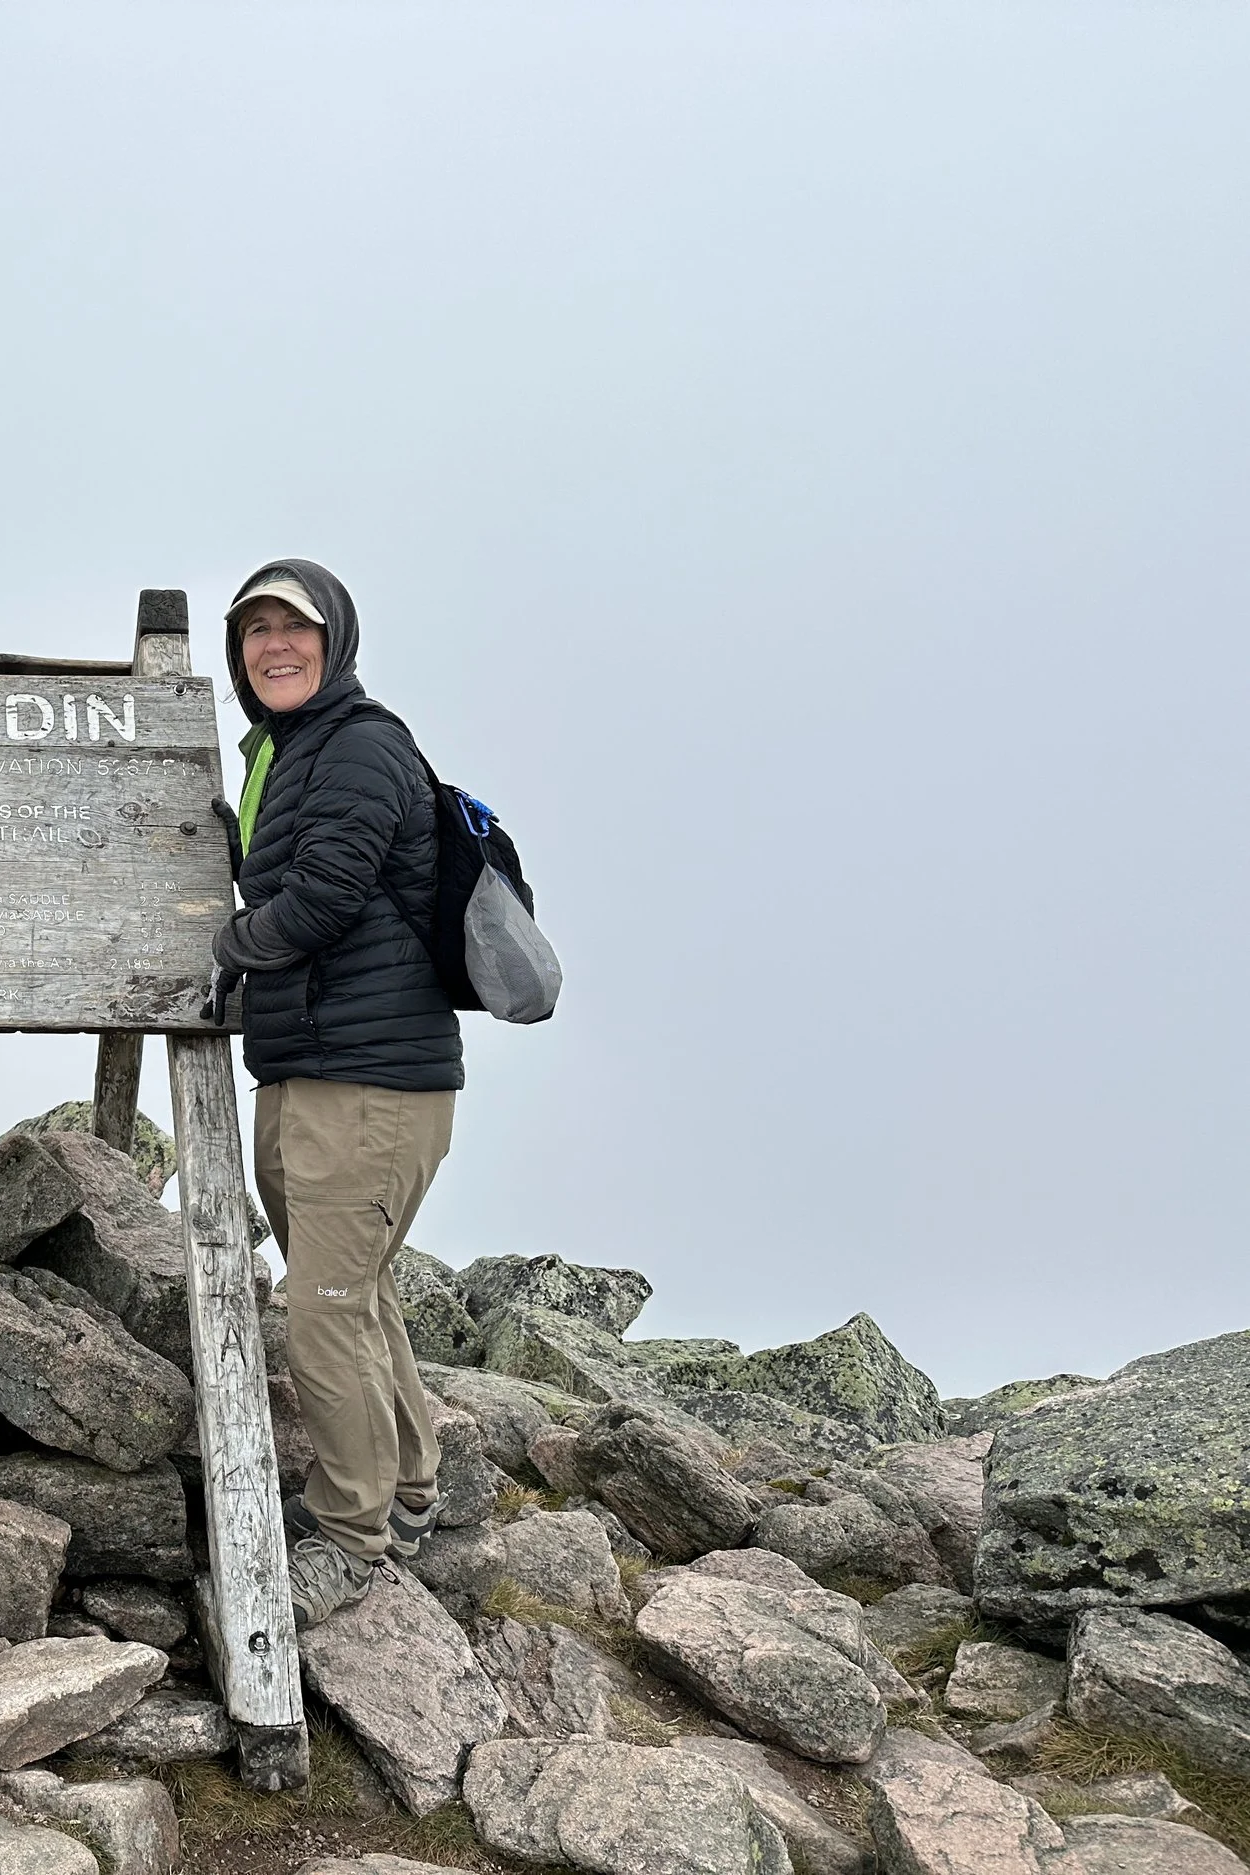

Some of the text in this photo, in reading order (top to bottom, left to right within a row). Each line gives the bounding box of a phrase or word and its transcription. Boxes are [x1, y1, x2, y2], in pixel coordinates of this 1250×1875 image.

[97, 758, 153, 776] 5267
[17, 804, 45, 819] OF
[51, 805, 91, 820] THE
[8, 893, 70, 905] SADDLE
[22, 909, 85, 921] SADDLE
[21, 957, 45, 968] the
[317, 1284, 349, 1297] baleaf
